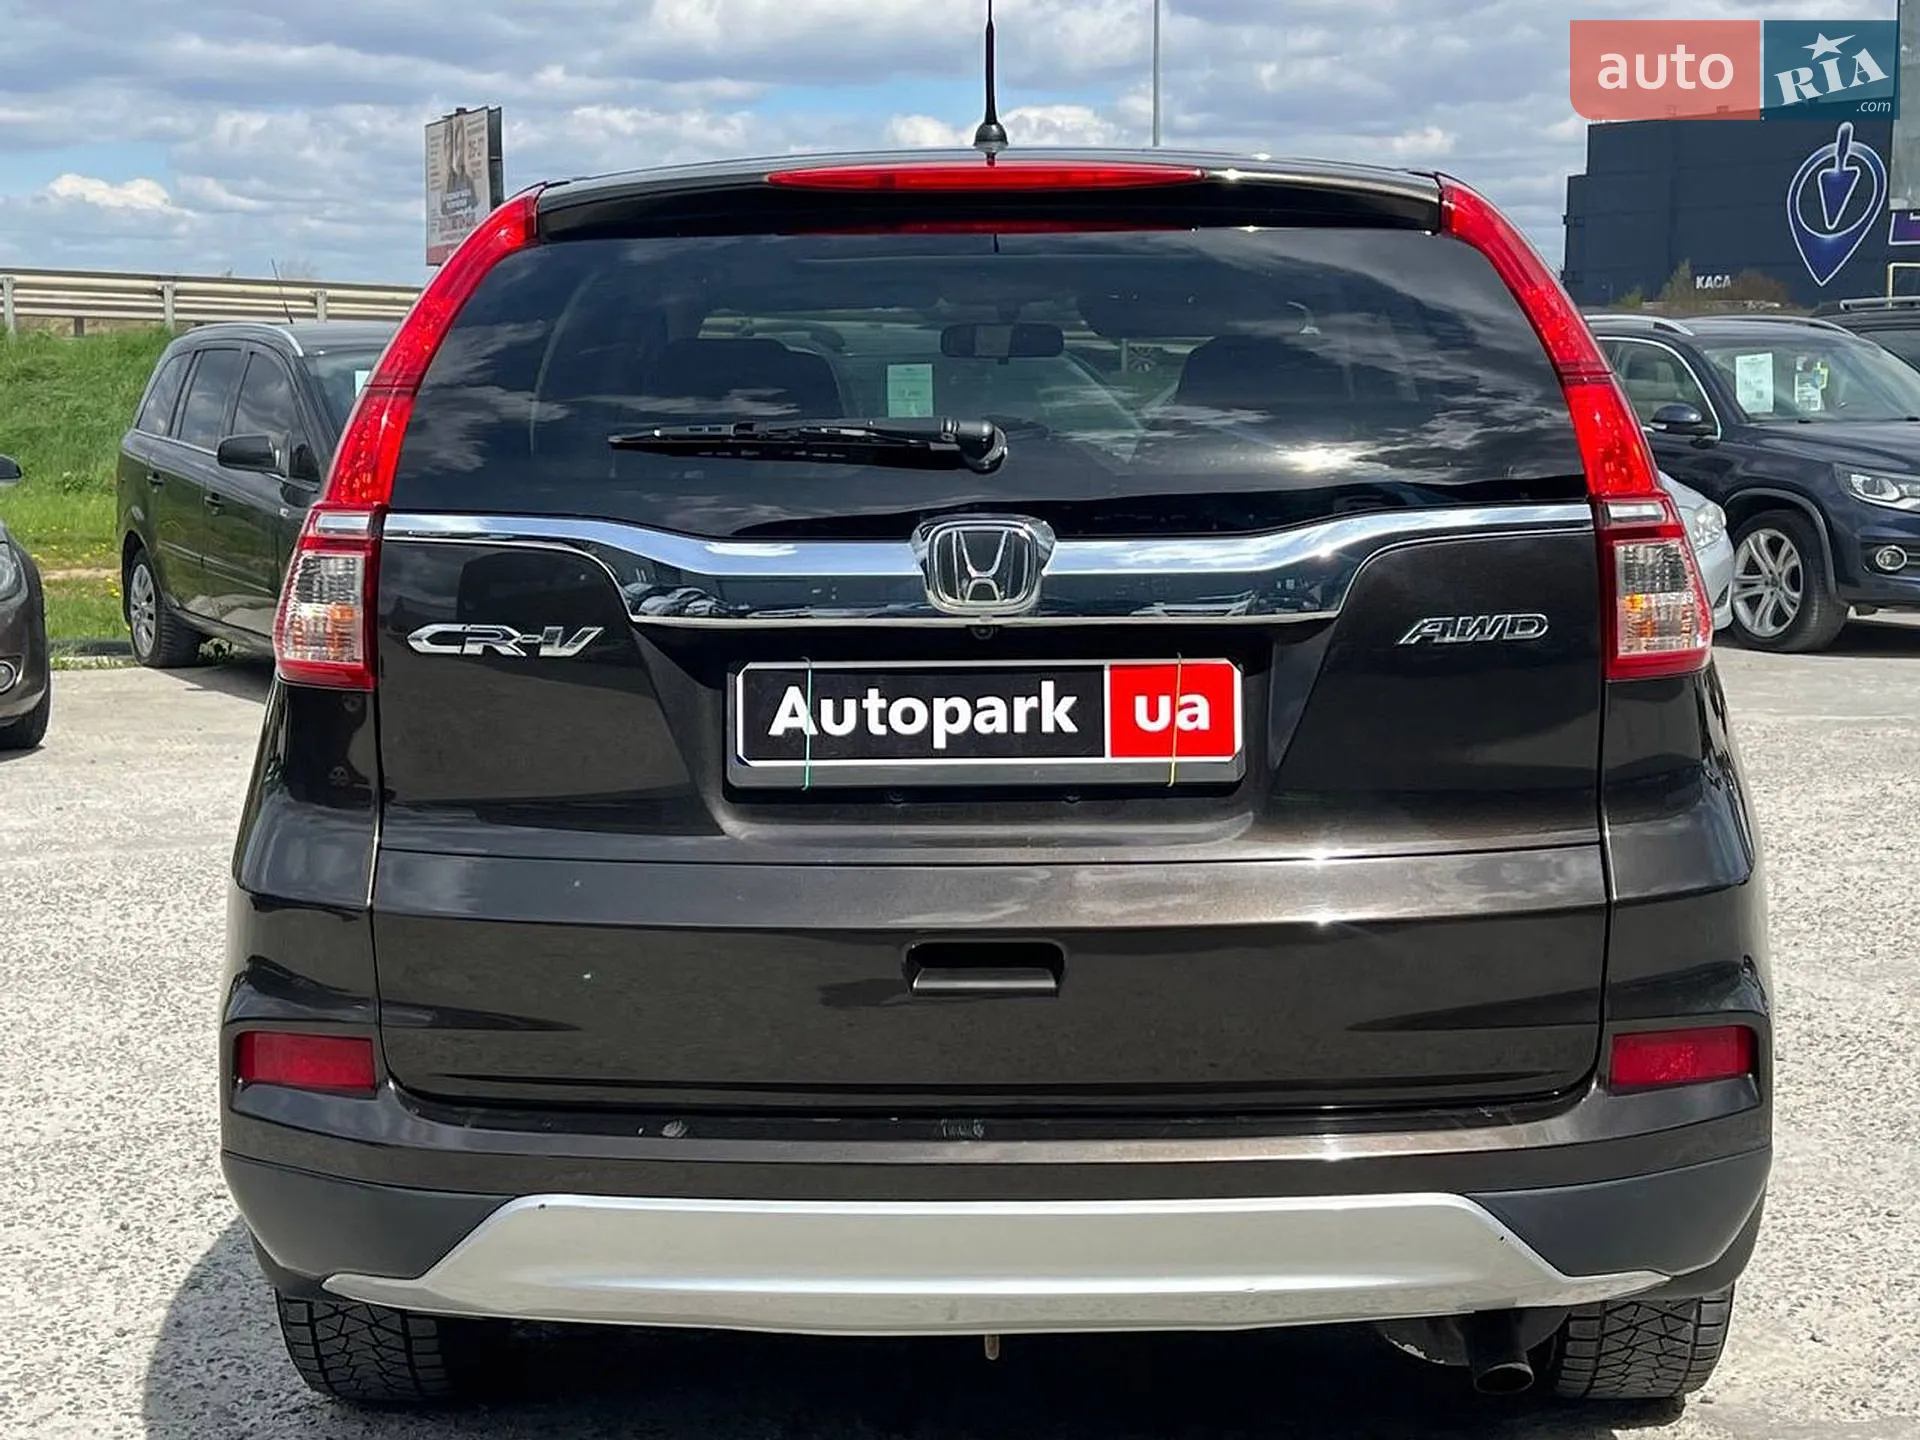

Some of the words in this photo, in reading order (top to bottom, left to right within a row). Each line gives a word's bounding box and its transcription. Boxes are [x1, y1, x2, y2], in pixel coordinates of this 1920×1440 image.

[1695, 275, 1731, 289] КАСА
[406, 623, 604, 657] CR-V
[1397, 613, 1549, 645] AWD
[767, 680, 1079, 750] Autopark
[1133, 690, 1212, 733] ua
